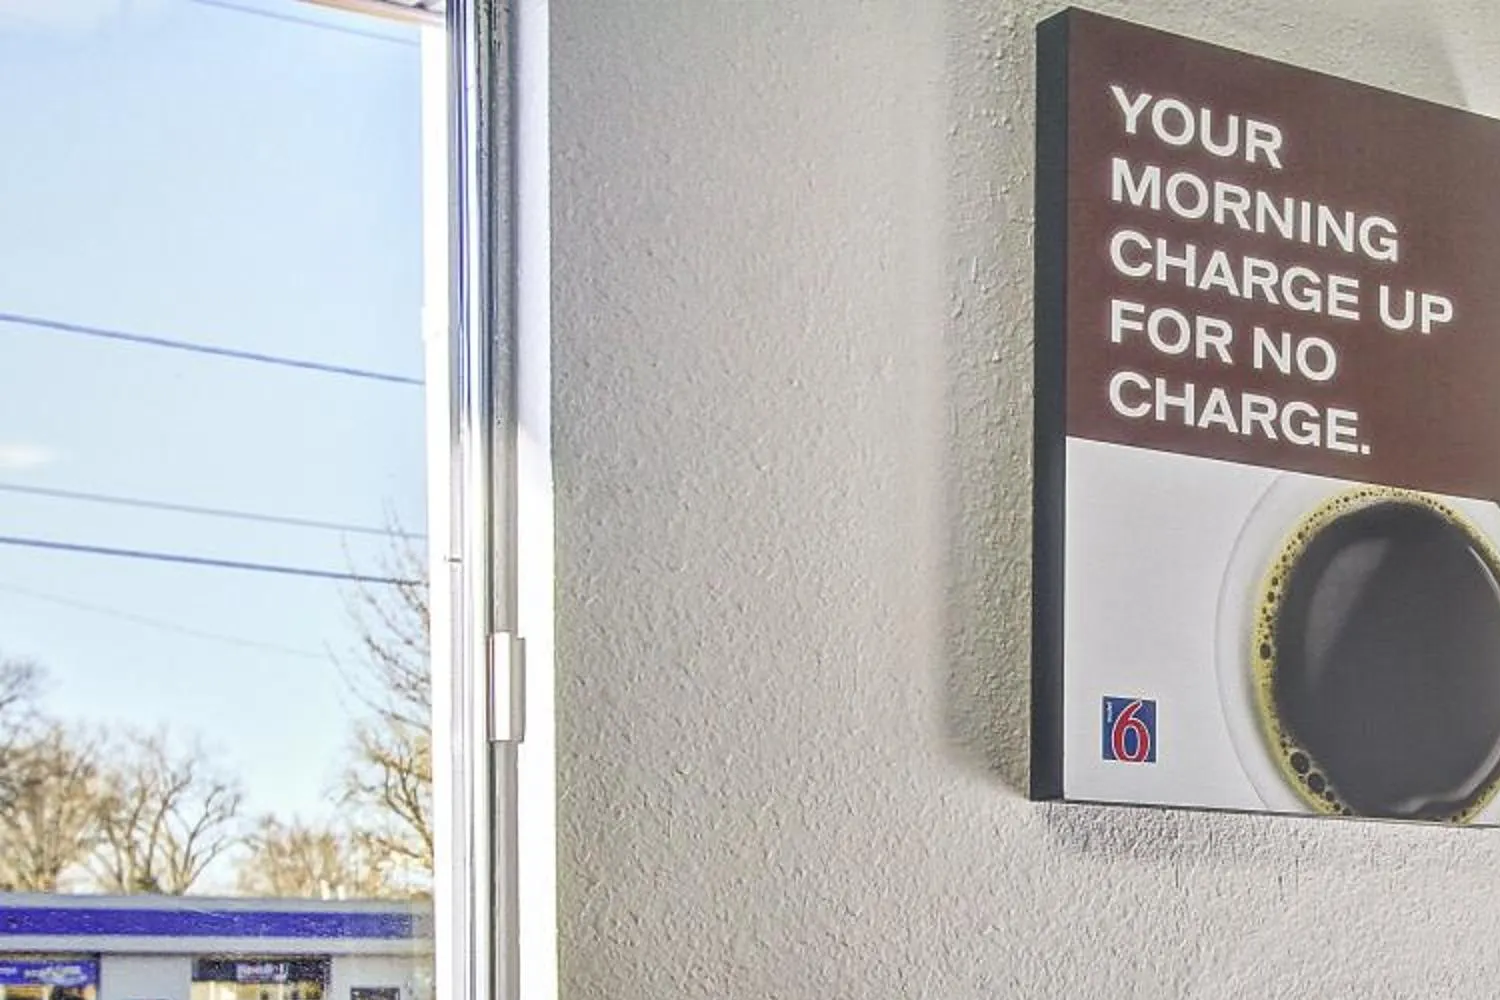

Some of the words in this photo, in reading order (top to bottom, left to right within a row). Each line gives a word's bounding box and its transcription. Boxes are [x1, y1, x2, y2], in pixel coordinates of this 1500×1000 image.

[1109, 84, 1284, 170] YOUR
[1110, 156, 1400, 263] MORNING
[1108, 229, 1362, 322] CHARGE
[1378, 283, 1455, 336] UP
[1110, 298, 1234, 364] FOR
[1252, 326, 1338, 382] NO
[1107, 371, 1372, 456] CHARGE.
[1111, 699, 1151, 764] 6
